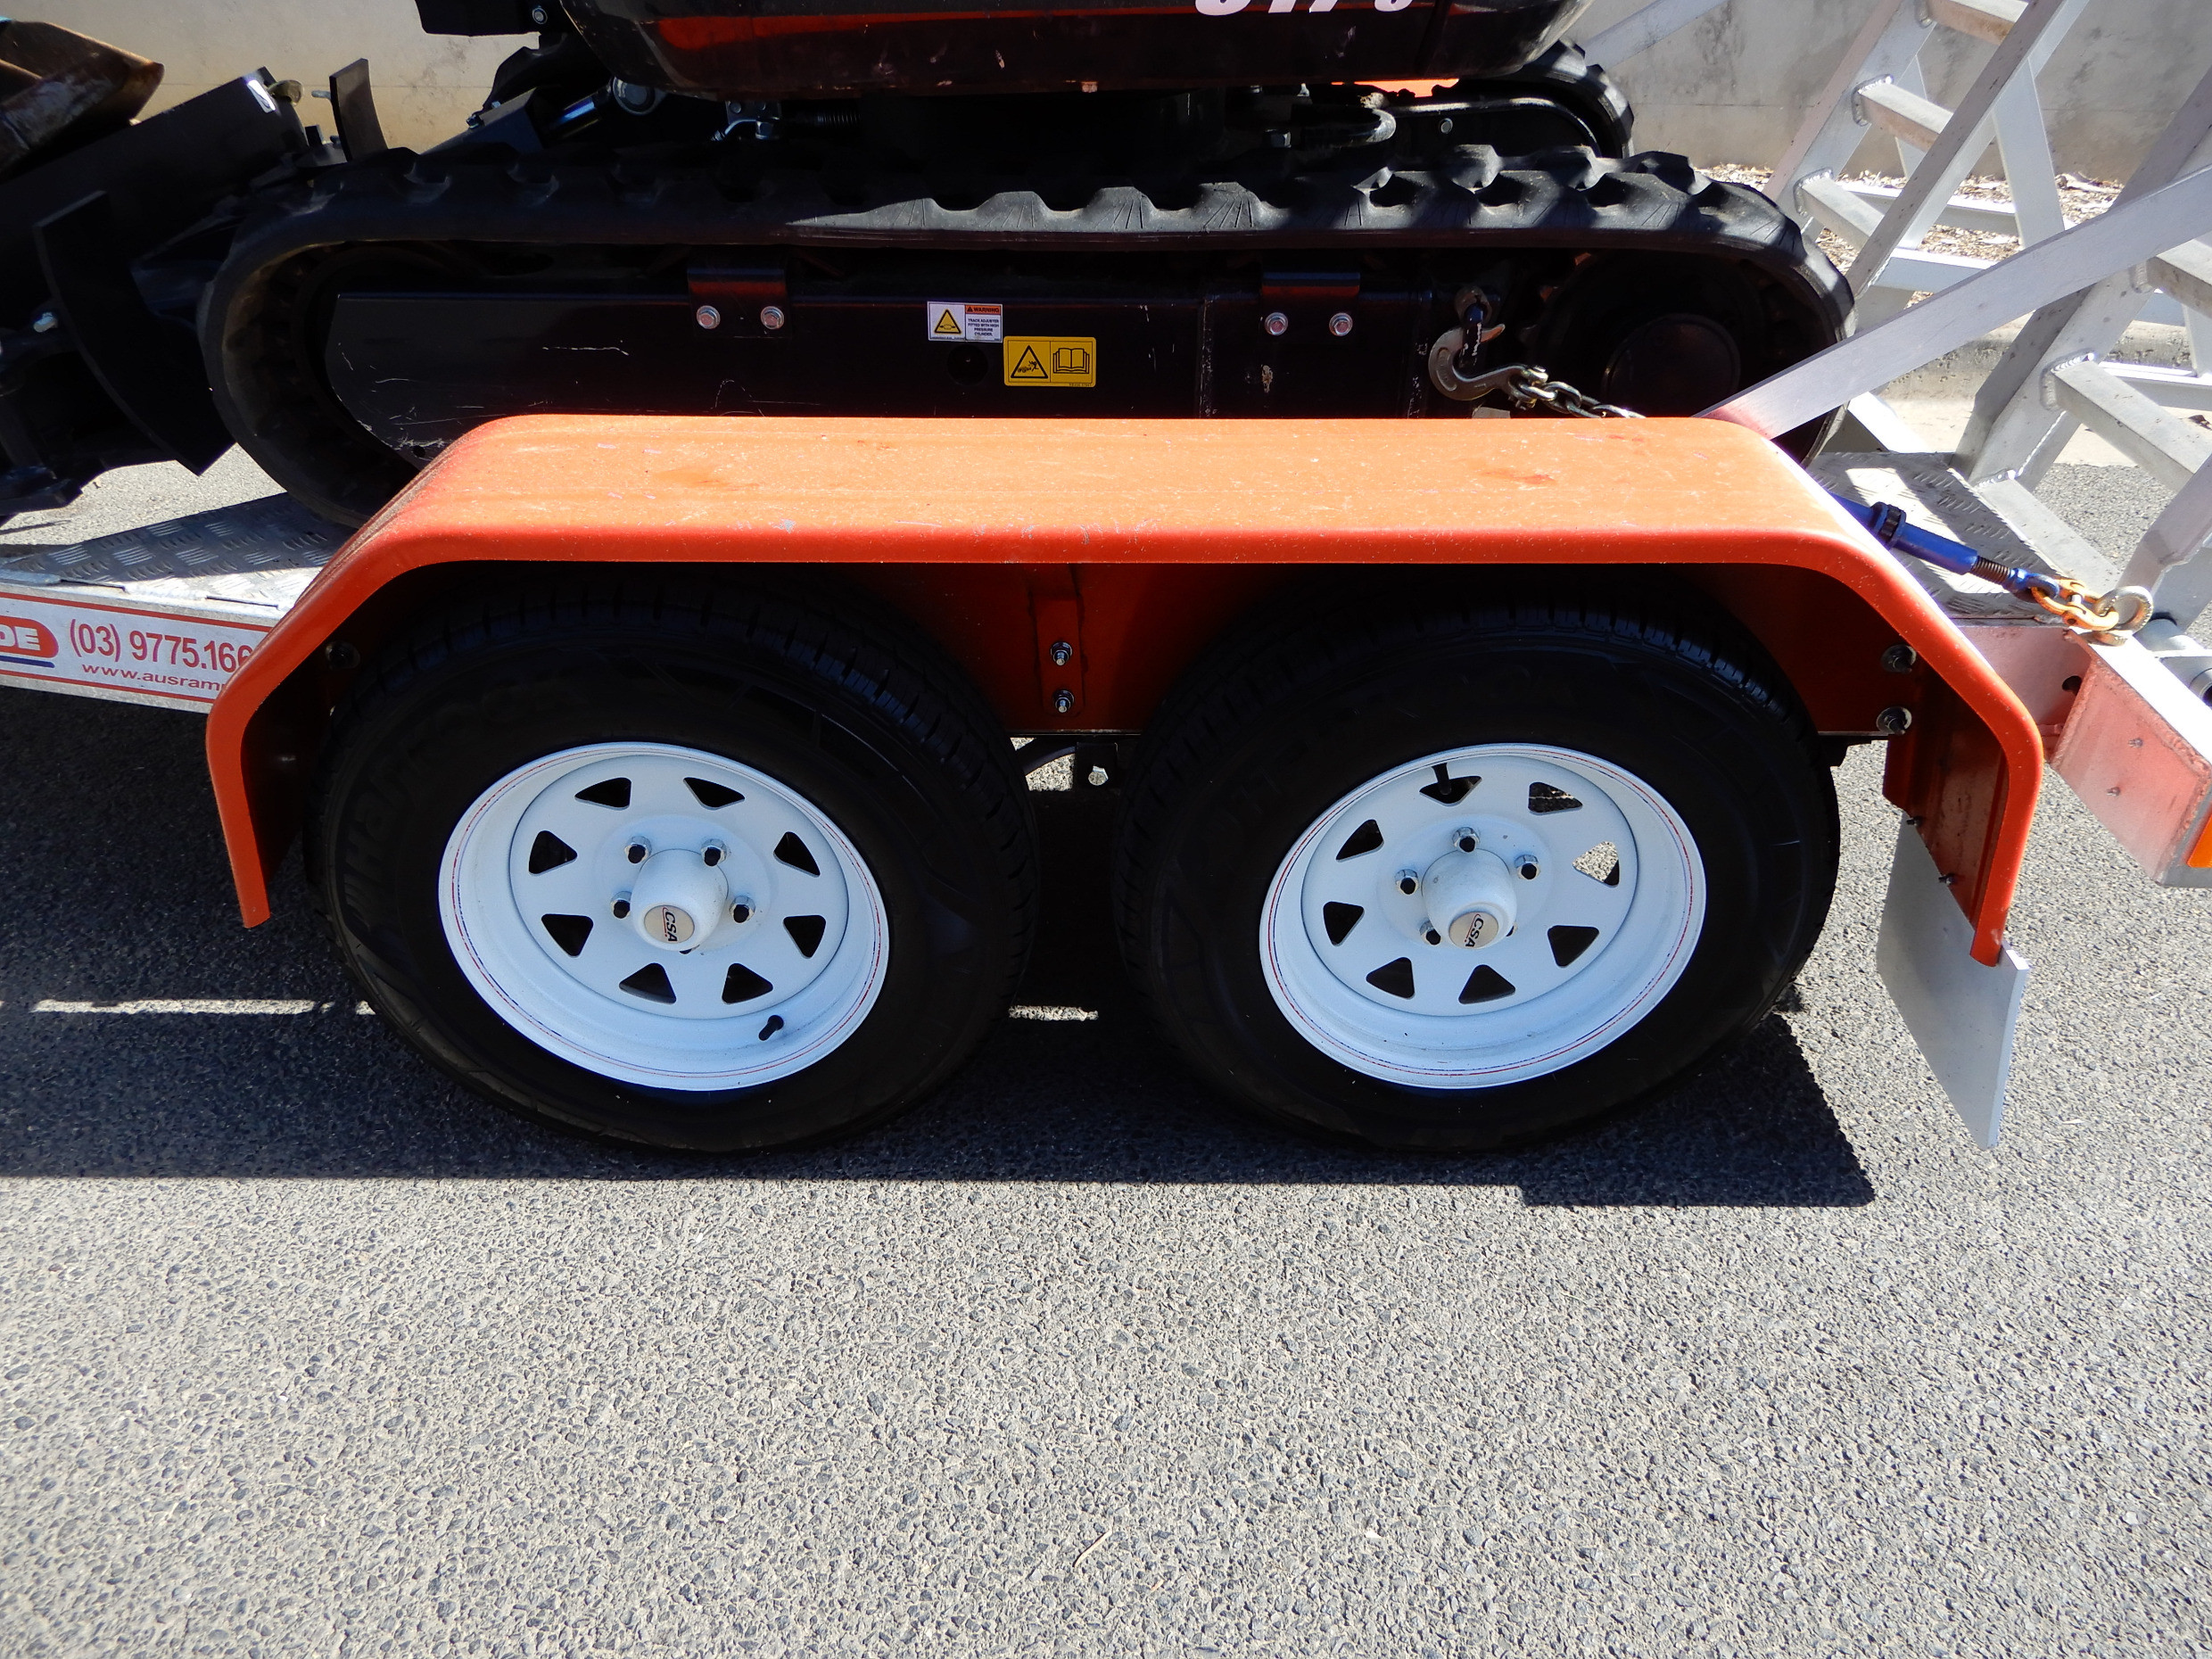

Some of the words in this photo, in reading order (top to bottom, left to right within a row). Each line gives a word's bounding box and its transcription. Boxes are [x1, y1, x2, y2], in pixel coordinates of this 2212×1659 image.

[70, 619, 121, 662] (03)
[82, 663, 226, 691] www.ausram
[665, 911, 678, 942] CSA
[1465, 917, 1484, 947] CSA
